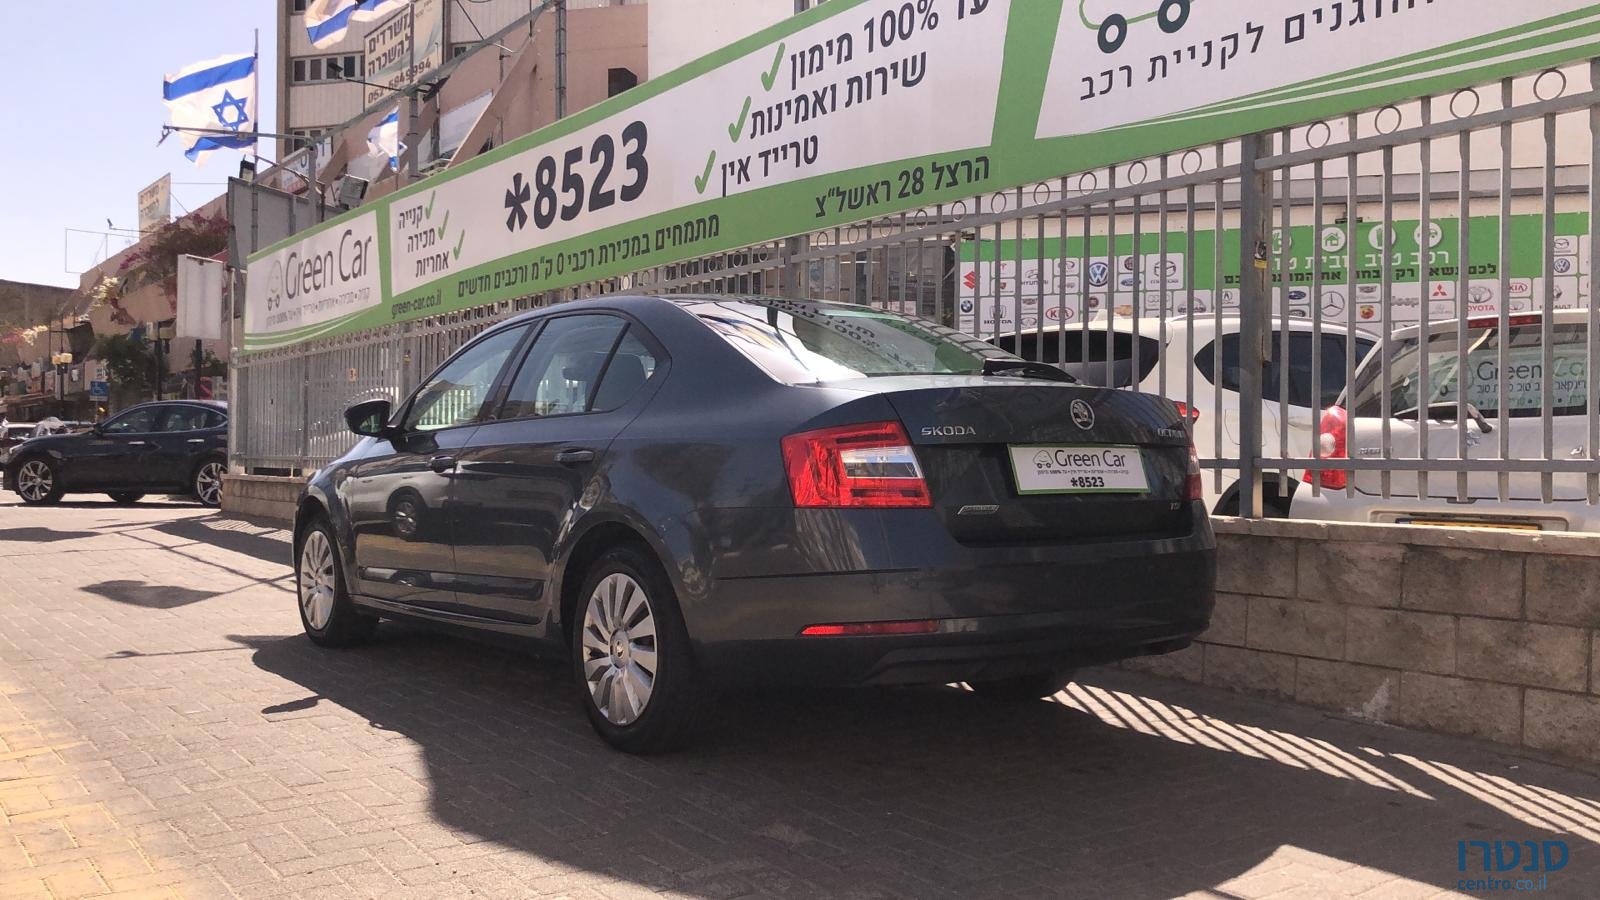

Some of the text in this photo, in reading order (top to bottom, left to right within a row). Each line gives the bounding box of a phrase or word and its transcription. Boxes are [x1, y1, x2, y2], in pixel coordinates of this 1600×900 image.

[863, 0, 939, 53] 100%
[791, 32, 853, 90] מימון
[1147, 21, 1264, 83] לקניית
[750, 51, 927, 140] שירות ואמינות
[1079, 64, 1133, 101] רכב
[721, 134, 819, 198] טרייד אין
[931, 155, 990, 191] הרצל
[898, 166, 925, 200] 28
[398, 204, 424, 230] קנייה
[407, 227, 436, 254] מכירה
[656, 213, 720, 251] מתמחים
[568, 251, 595, 273] רכבי
[598, 233, 651, 264] במכירת
[285, 229, 373, 300] Green Car
[415, 250, 451, 279] אחריות
[494, 264, 528, 289] ורכבים
[556, 252, 565, 275] 0
[1320, 271, 1342, 281] את
[1395, 268, 1415, 281] רק
[1467, 262, 1498, 276] לכם
[457, 273, 491, 298] חדשים
[391, 288, 442, 320] green-car.co.il
[1049, 308, 1070, 318] KA
[921, 425, 977, 436] SKODA
[1054, 449, 1126, 468] Green Car
